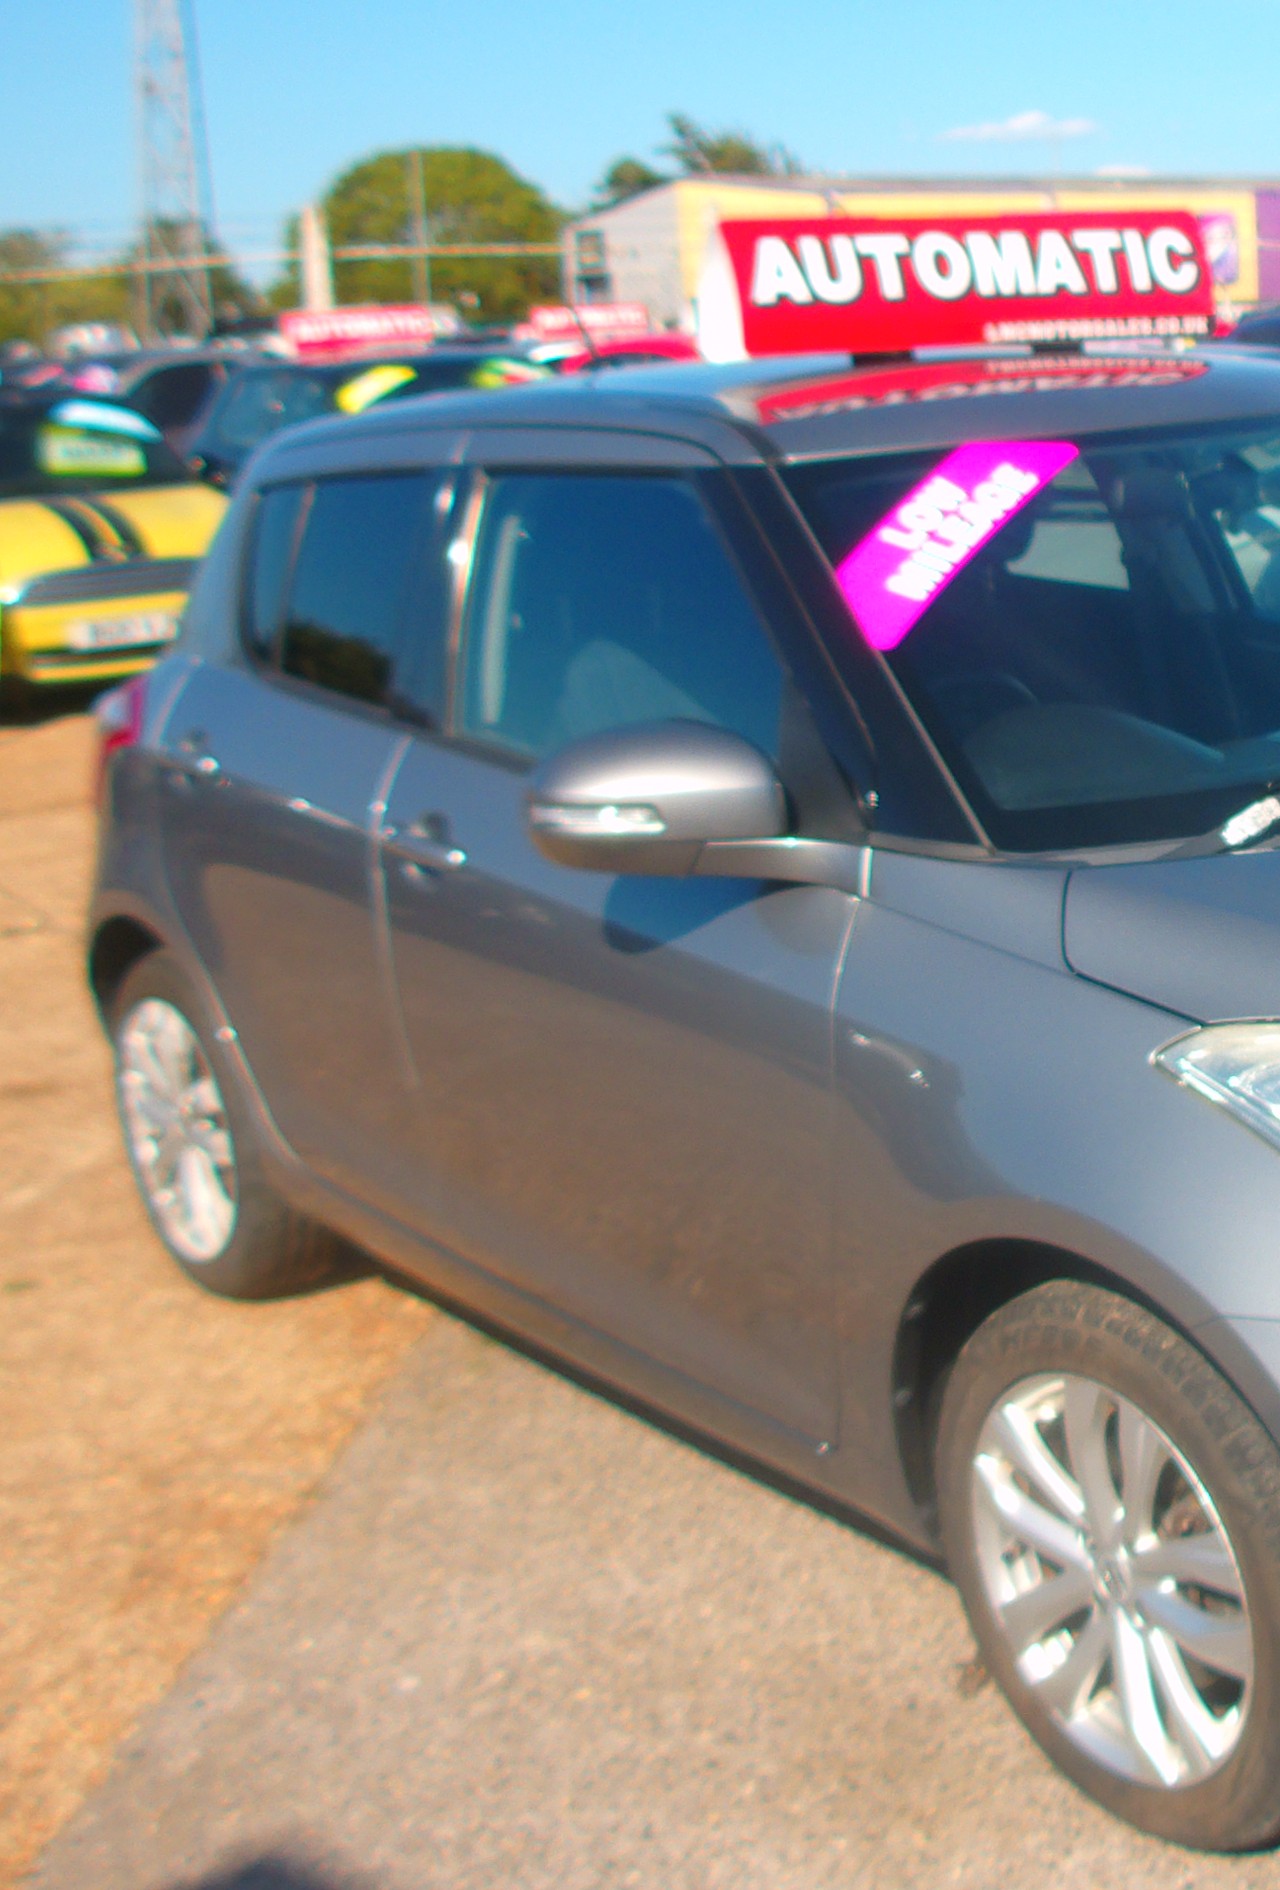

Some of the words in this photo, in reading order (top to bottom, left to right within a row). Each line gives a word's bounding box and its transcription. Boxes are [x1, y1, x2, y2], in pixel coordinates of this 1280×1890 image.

[752, 226, 1202, 305] AUTOMATIC
[877, 475, 970, 551] LOW
[884, 461, 1041, 603] MILEAGE
